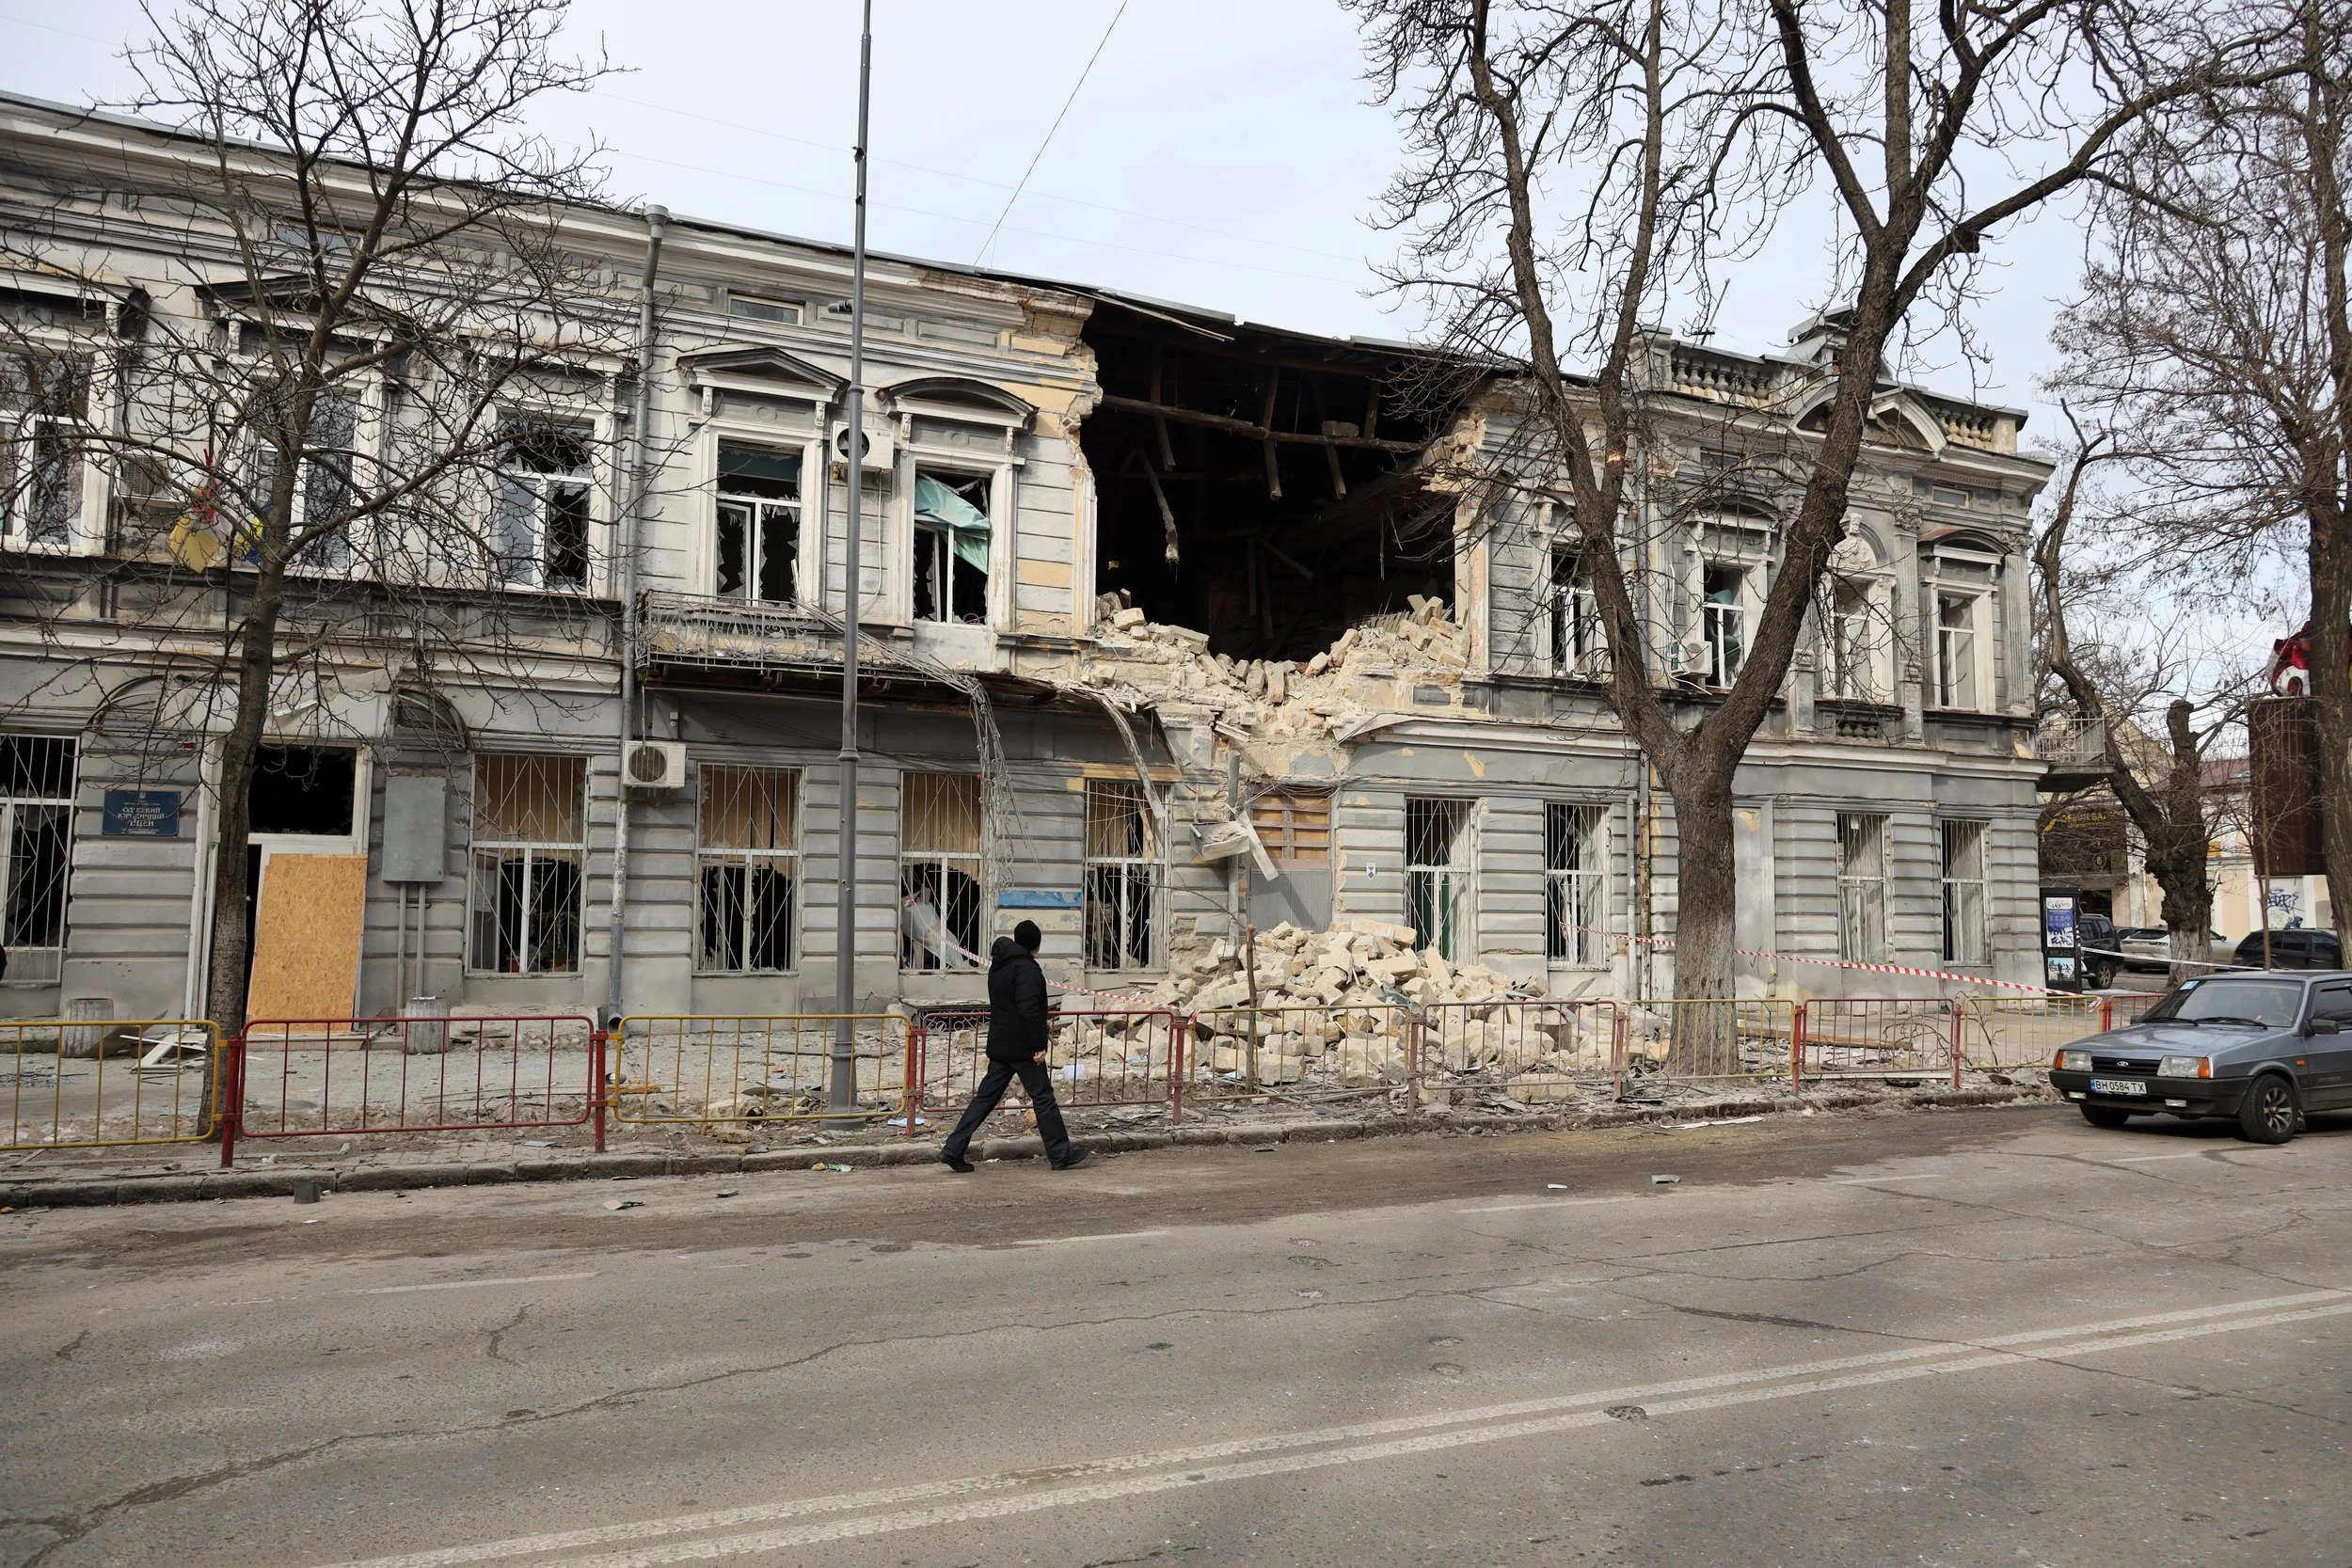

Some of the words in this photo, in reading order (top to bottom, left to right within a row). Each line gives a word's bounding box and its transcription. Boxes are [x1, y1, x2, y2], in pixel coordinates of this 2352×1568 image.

[2095, 1080, 2108, 1090] BH
[2108, 1081, 2130, 1091] 0584
[2131, 1083, 2145, 1093] TX
